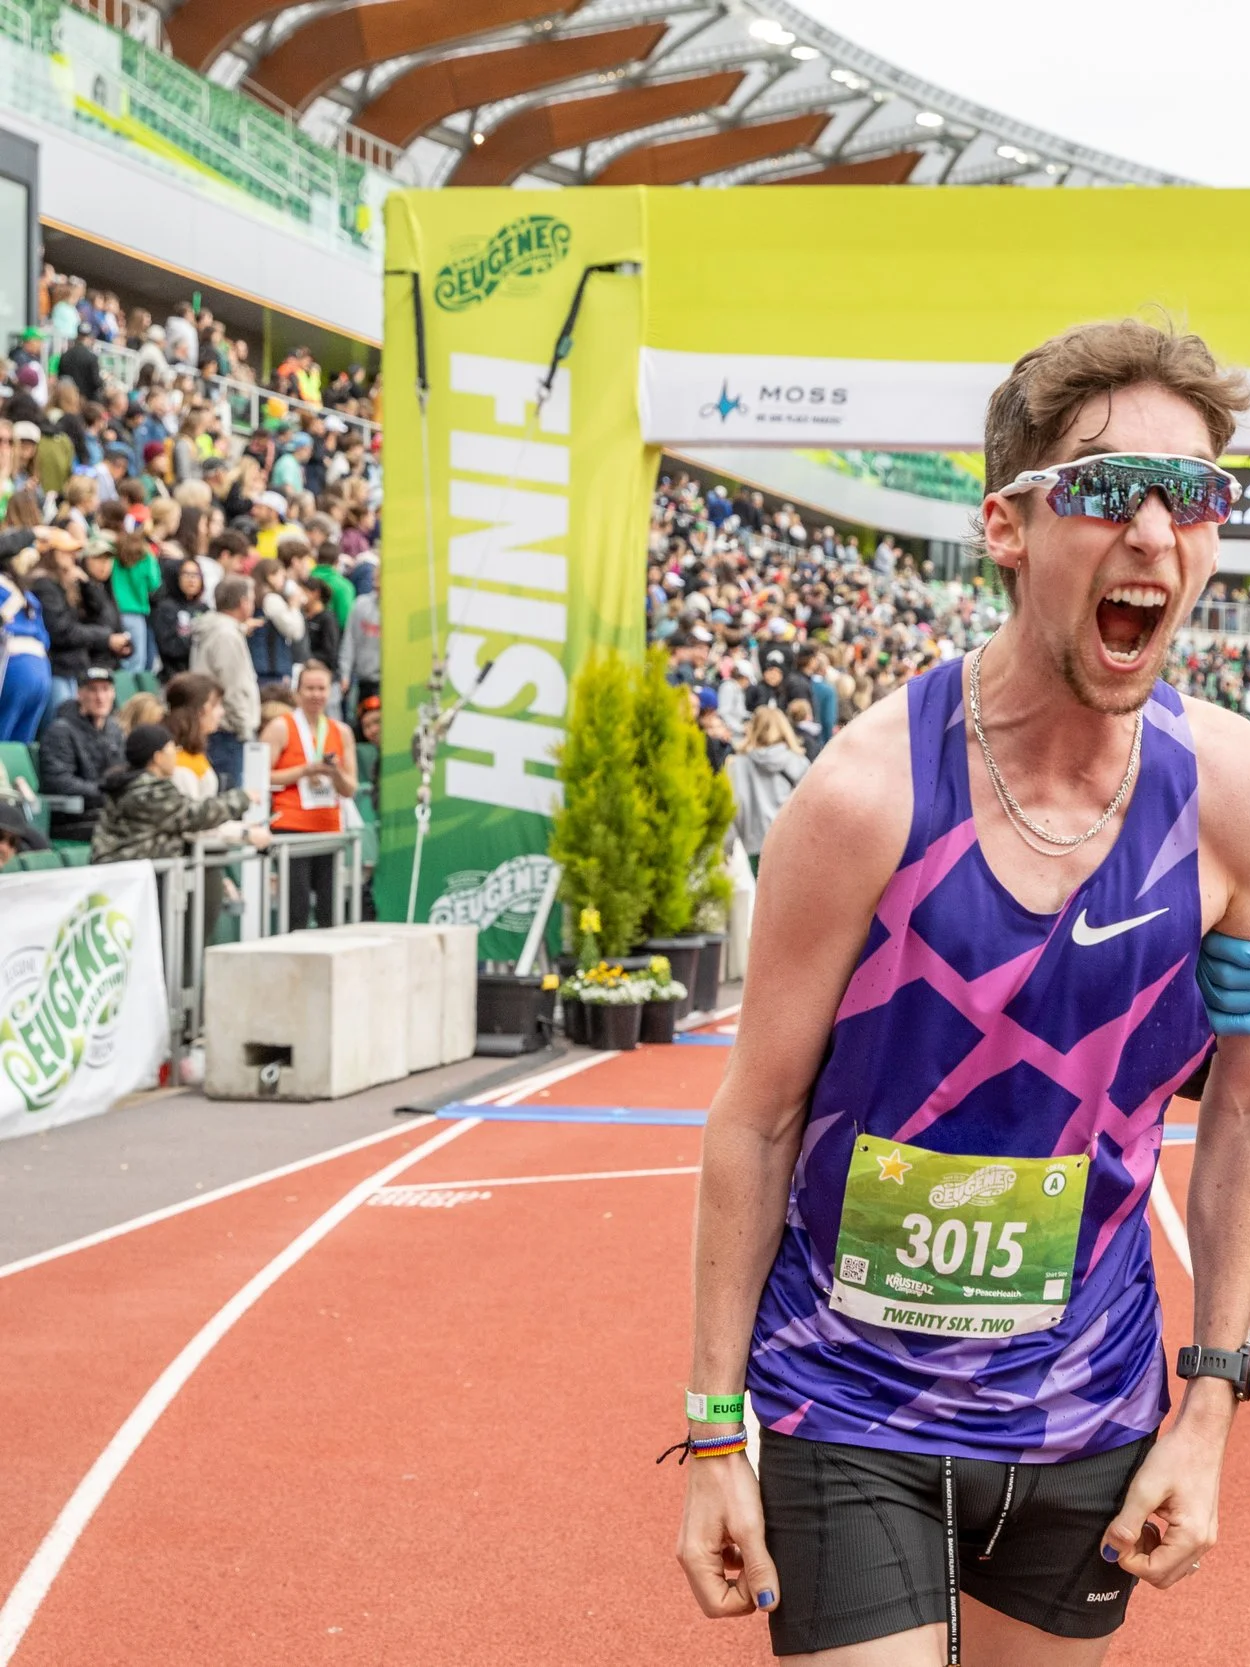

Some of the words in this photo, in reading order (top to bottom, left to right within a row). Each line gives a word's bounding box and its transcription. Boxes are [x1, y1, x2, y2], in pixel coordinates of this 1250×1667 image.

[457, 224, 549, 296] EUGENE
[759, 385, 848, 405] MOSS
[446, 352, 571, 818] FINISH
[18, 912, 120, 1082] EUGENE
[944, 1169, 1005, 1204] EUGENE
[1049, 1177, 1058, 1191] A
[896, 1213, 1028, 1278] 3015
[885, 1273, 934, 1295] KRUSTEAZ
[975, 1288, 1022, 1298] PeaceHealth
[882, 1306, 947, 1330] TWENTY
[713, 1403, 743, 1414] EUGE
[1086, 1589, 1120, 1603] BANDIT
